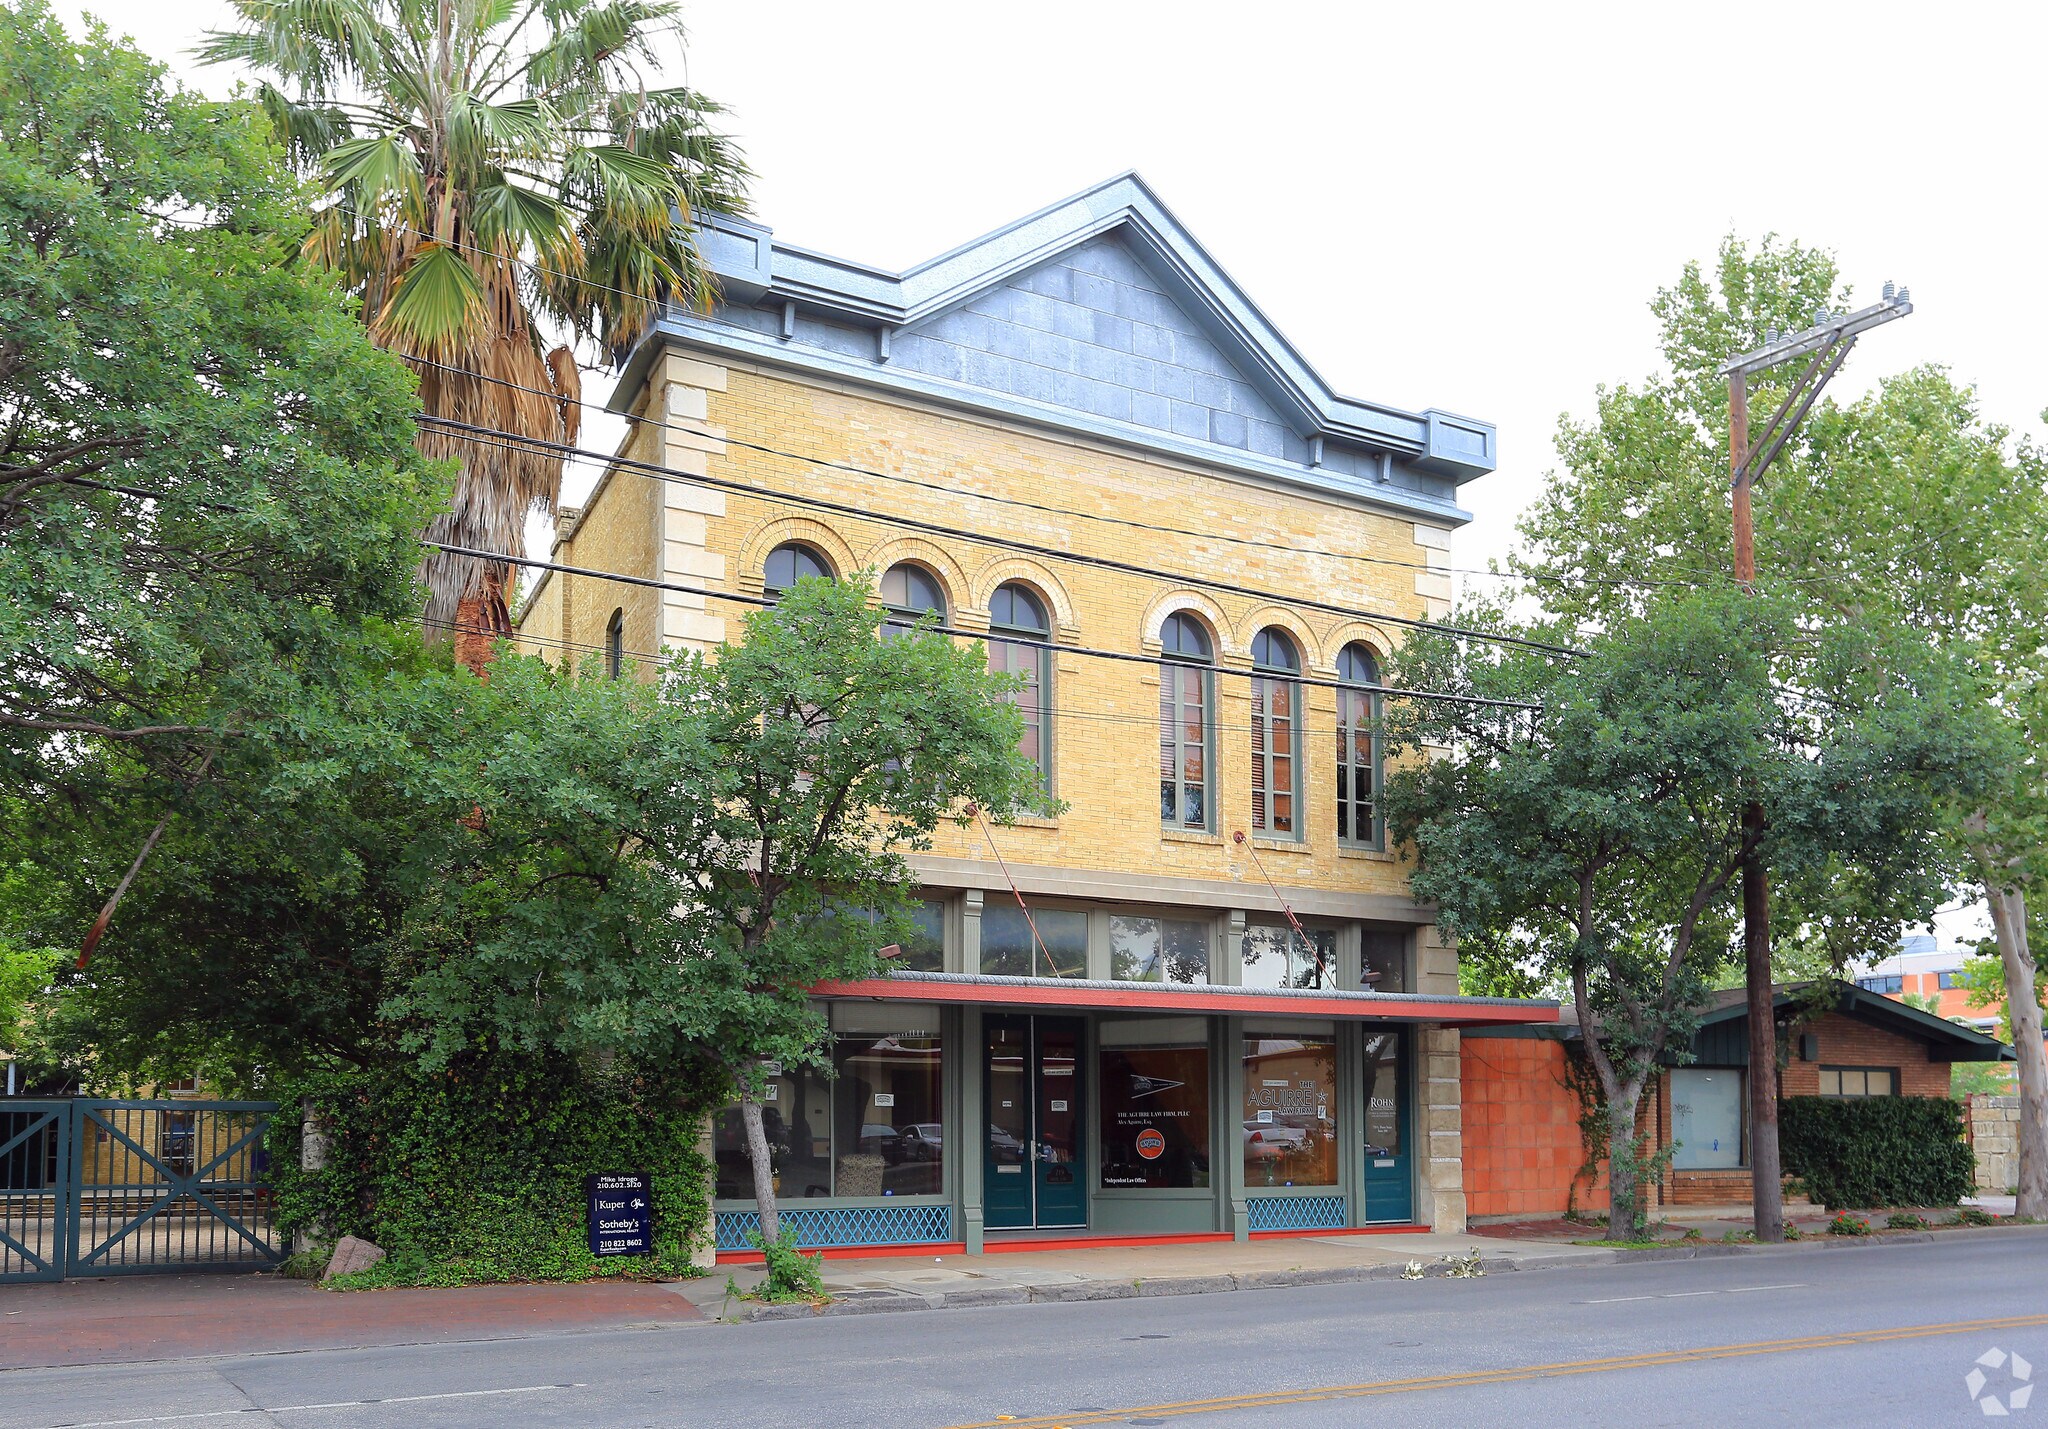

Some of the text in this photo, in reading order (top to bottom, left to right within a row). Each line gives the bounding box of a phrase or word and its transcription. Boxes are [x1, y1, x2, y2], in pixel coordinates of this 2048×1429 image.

[1299, 1080, 1313, 1089] THE
[1247, 1088, 1312, 1107] AGUIRRE
[1370, 1097, 1394, 1108] ROHN
[1277, 1106, 1313, 1115] LAW FIRM
[599, 1200, 625, 1211] Kuper
[599, 1218, 639, 1230] Sotheby's
